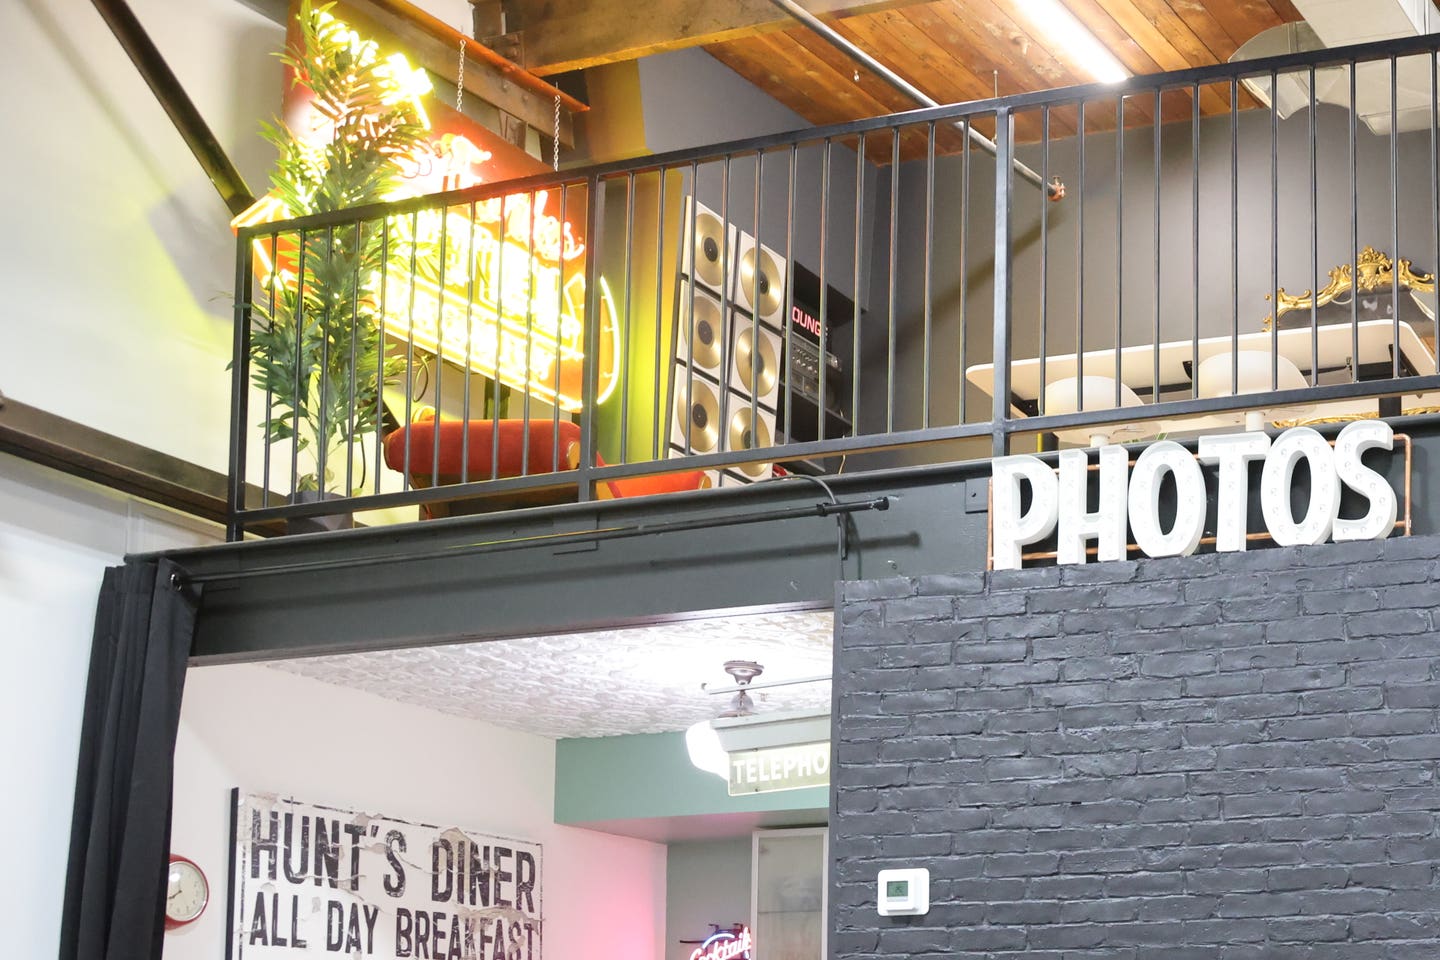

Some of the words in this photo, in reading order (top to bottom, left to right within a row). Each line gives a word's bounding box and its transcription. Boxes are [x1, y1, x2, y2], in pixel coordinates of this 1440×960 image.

[790, 305, 824, 338] OUNG
[992, 420, 1397, 570] PHOTOS
[251, 808, 407, 898] HUNT'S
[431, 838, 536, 913] DINER
[249, 891, 307, 949] ALL
[326, 900, 379, 955] DAY
